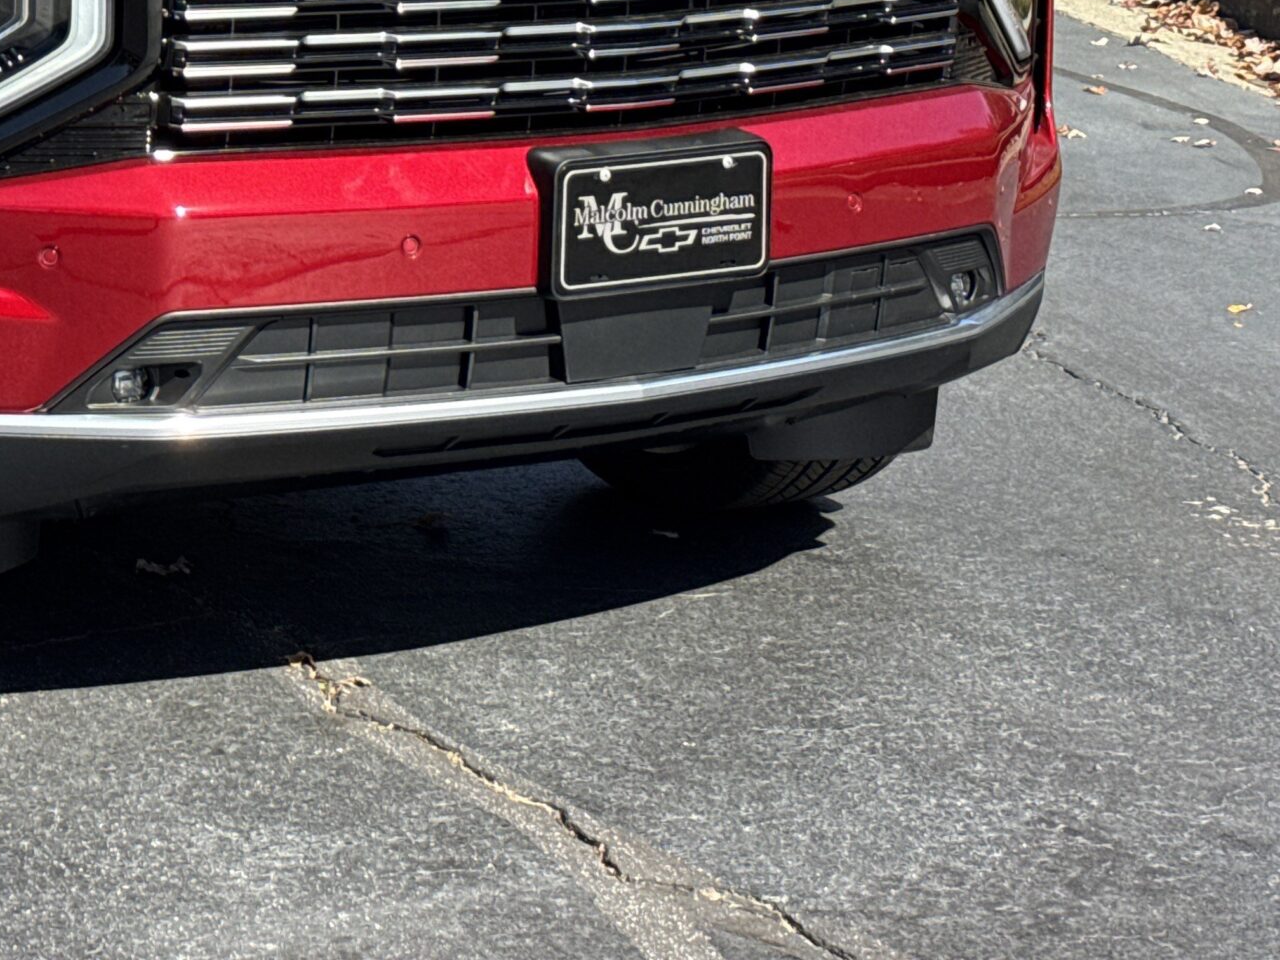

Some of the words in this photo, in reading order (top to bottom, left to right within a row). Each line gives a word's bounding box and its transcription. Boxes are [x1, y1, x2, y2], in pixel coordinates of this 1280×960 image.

[573, 202, 648, 227] Malcolm
[650, 192, 755, 216] Cunningham
[701, 222, 752, 235] CHEVROLET
[701, 234, 729, 245] NORTH
[729, 231, 752, 242] POINT
